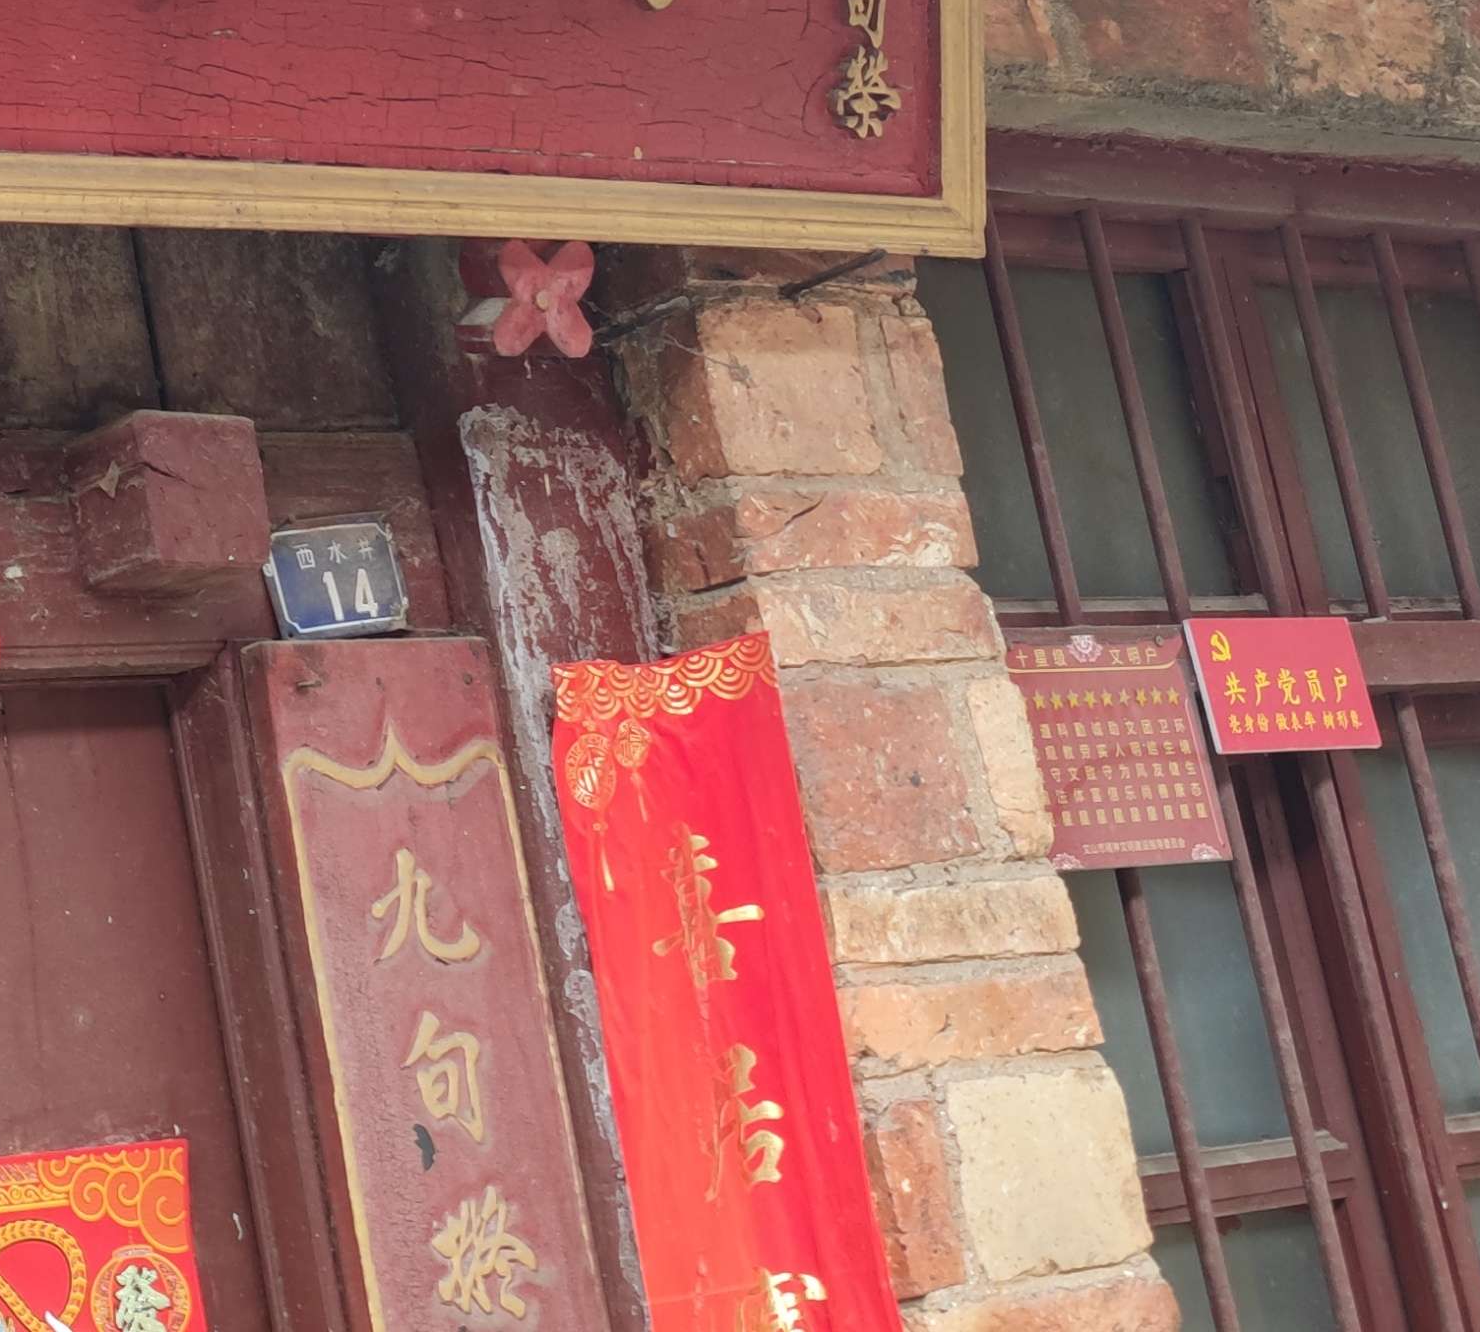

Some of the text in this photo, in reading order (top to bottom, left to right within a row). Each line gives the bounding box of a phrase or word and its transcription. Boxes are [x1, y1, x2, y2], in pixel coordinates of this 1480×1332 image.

[292, 538, 376, 570] 西水井
[322, 568, 379, 621] 14
[1016, 645, 1158, 668] 十星级 文明户
[1224, 667, 1349, 707] 共产党员户
[1228, 709, 1363, 734] 亮身份 做表率 树形象
